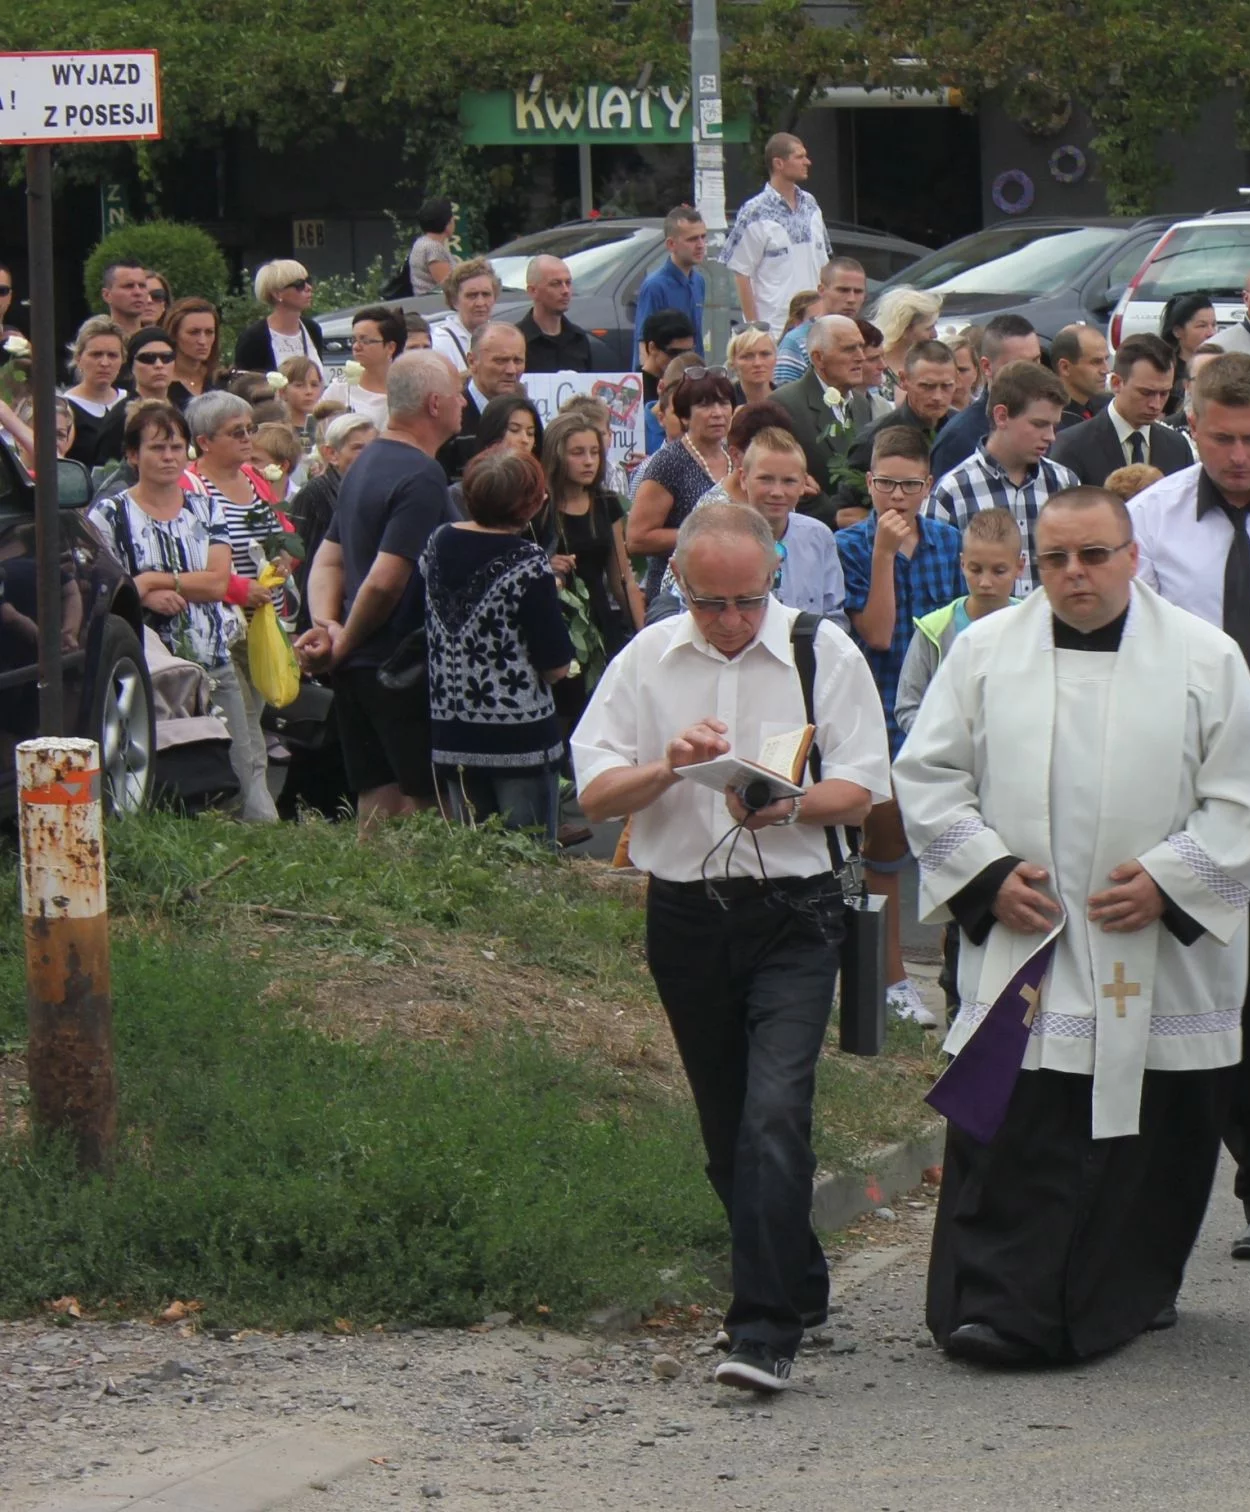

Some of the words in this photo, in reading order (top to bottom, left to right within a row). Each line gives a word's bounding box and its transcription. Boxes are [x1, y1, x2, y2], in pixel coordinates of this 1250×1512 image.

[52, 63, 141, 86] WYJAZD
[44, 105, 58, 127] Z
[65, 103, 154, 127] POSESJI
[516, 86, 691, 129] KWIATY
